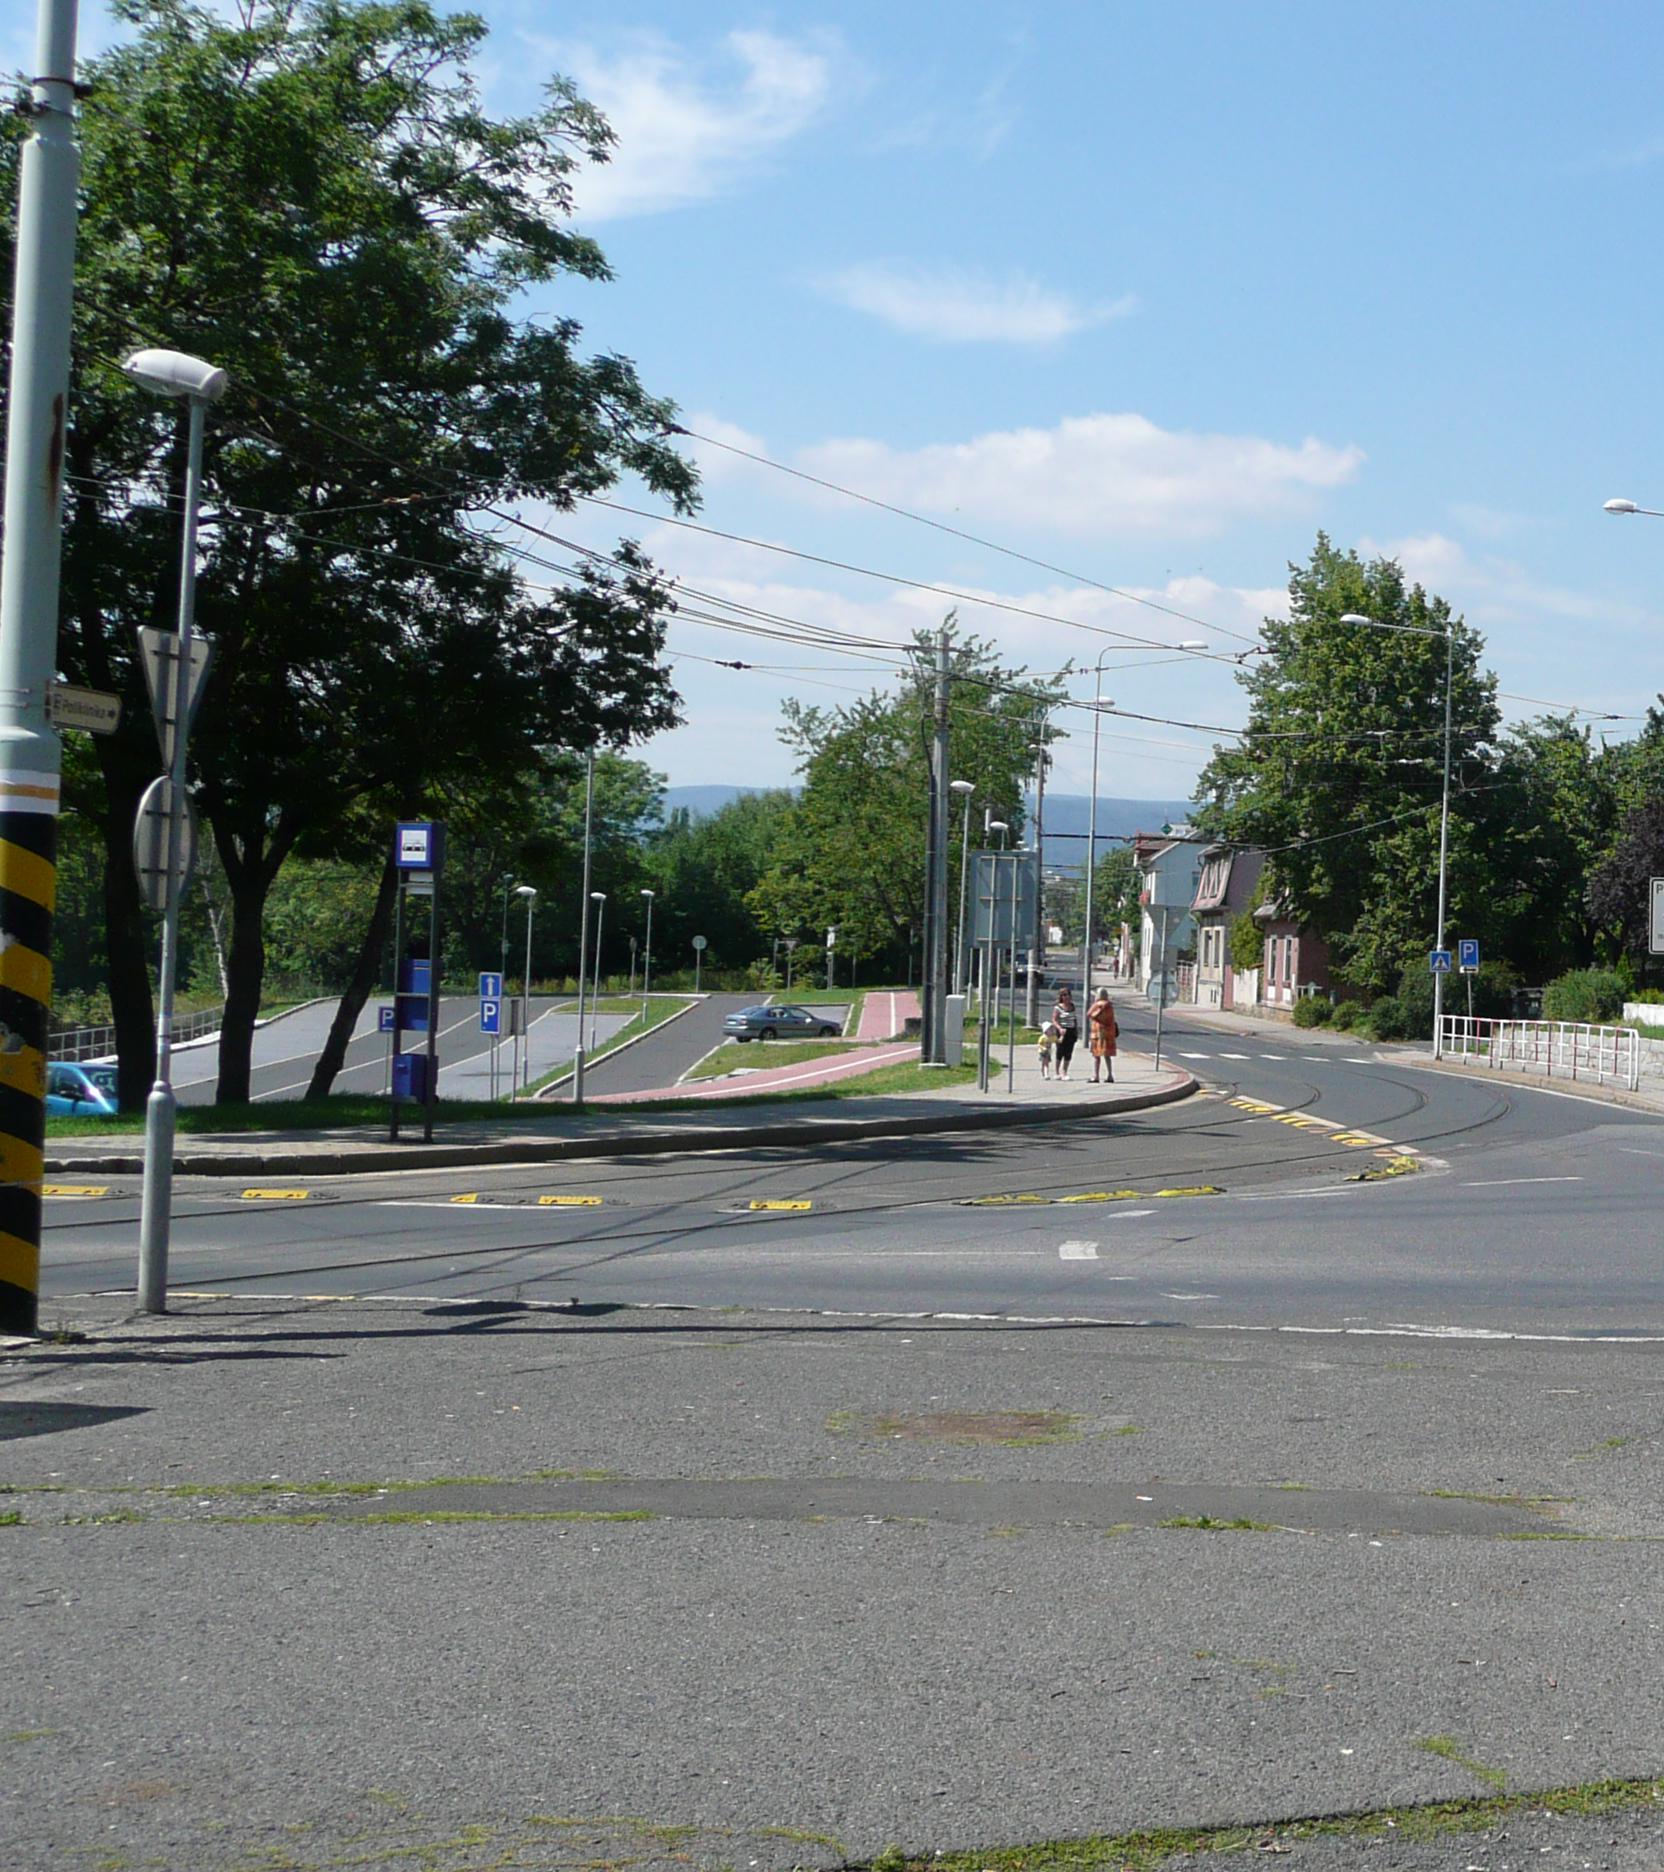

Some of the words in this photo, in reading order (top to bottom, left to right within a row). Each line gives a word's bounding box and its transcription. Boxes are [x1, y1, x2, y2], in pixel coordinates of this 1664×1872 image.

[1463, 943, 1474, 959] P
[382, 1009, 394, 1025] P
[483, 1003, 496, 1022] P
